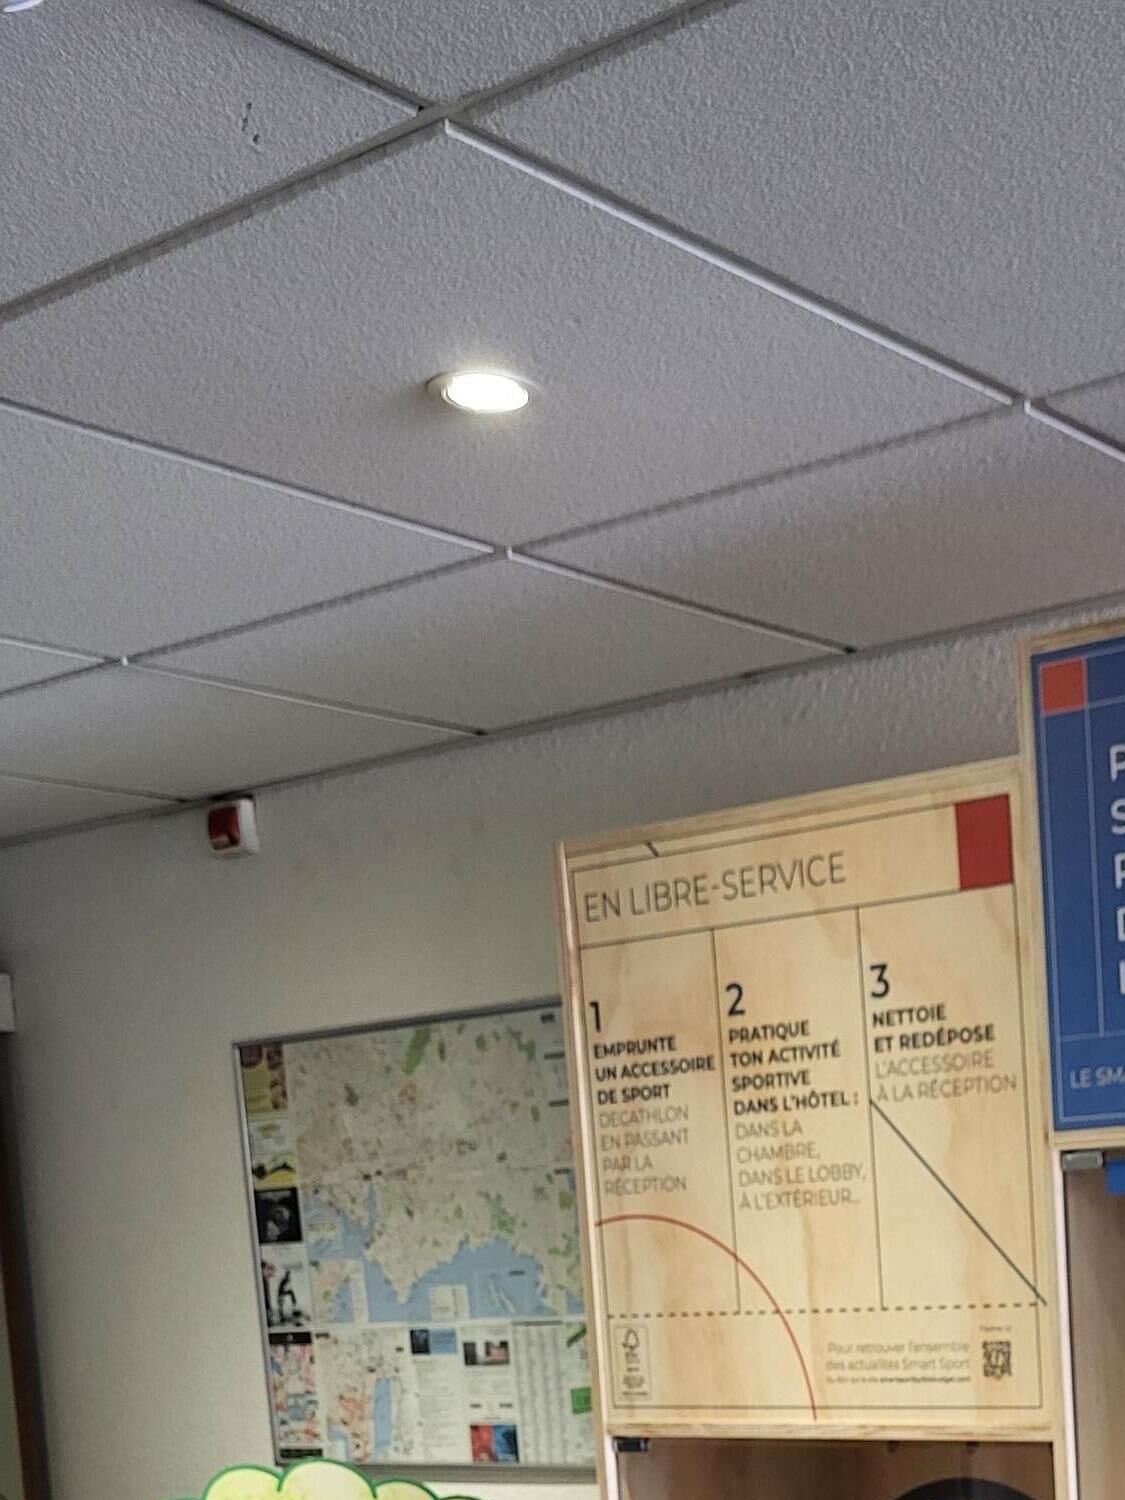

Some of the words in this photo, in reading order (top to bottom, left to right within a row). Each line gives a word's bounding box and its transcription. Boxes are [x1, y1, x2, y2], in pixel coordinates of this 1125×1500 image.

[584, 892, 621, 923] EN
[630, 850, 847, 917] LIBRE-SERVICE
[869, 963, 891, 999] 3
[725, 982, 746, 1017] 2
[589, 1000, 601, 1033] 1
[872, 1003, 946, 1027] NETTOIE
[729, 1020, 810, 1044] PRATIQUE
[874, 1036, 895, 1053] ET
[899, 1024, 995, 1050] REDÉPOSE
[594, 1035, 676, 1059] EMPRUNTE
[731, 1050, 764, 1068] TON
[768, 1039, 841, 1064] ACTIVITÉ
[595, 1064, 617, 1082] UN
[619, 1054, 715, 1079] ACCESSOIRE
[874, 1050, 995, 1079] L'ACCESSOIRE
[732, 1069, 810, 1092] SPORTIVE
[890, 1083, 914, 1102] LA
[917, 1071, 1017, 1100] RÉCEPTION
[1070, 1069, 1091, 1089] LE
[598, 1089, 619, 1105] DE
[622, 1084, 670, 1103] SPORT
[734, 1097, 778, 1116] DANS
[783, 1089, 848, 1112] L'HÔTEL
[601, 1133, 622, 1150] EN
[624, 1129, 689, 1147] PASSANT
[735, 1121, 779, 1139] DANS
[782, 1119, 803, 1137] LA
[603, 1156, 630, 1172] PAR
[633, 1155, 654, 1170] LA
[604, 1173, 688, 1197] RÉCEPTION
[739, 1168, 780, 1186] DANS
[783, 1167, 804, 1184] LE
